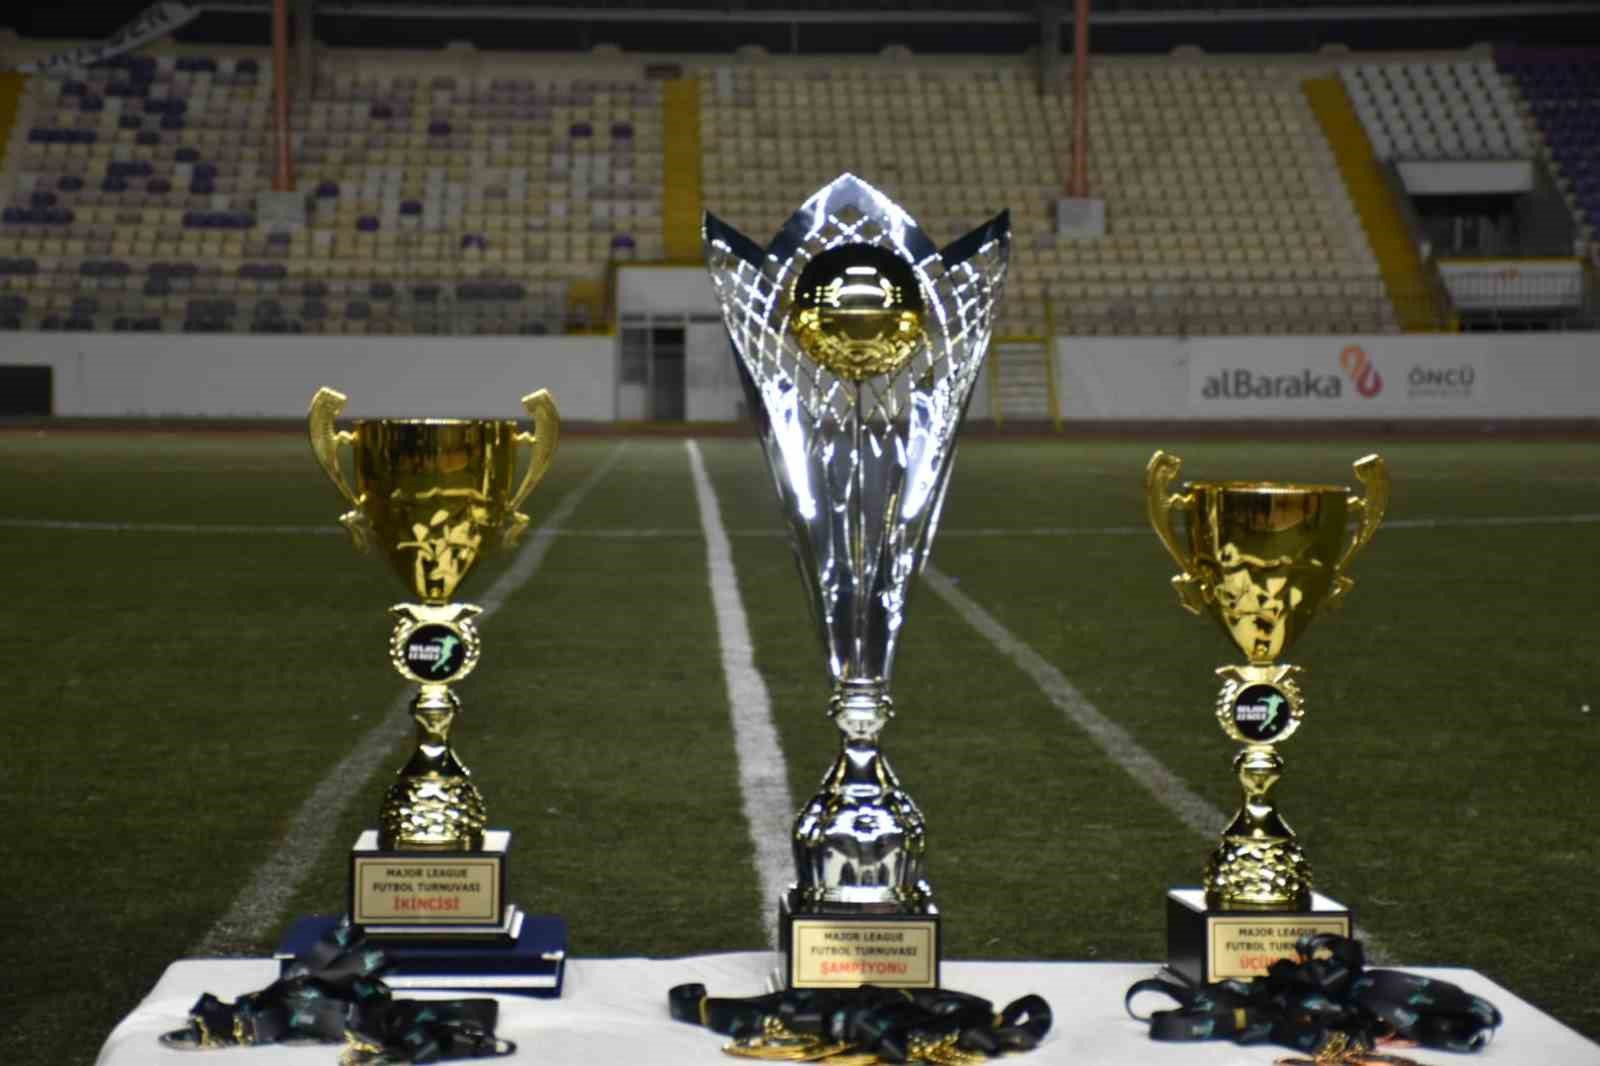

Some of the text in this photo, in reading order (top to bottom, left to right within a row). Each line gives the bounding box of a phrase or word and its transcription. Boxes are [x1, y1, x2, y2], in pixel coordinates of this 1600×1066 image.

[1408, 364, 1475, 386] ÖNCÜ
[1202, 368, 1342, 399] alBaraka
[386, 868, 468, 878] MAJOR LEAGUE
[373, 882, 480, 892] FUTBOL TURNUVASI
[824, 932, 904, 942] MAJOR LEAGUE
[1239, 928, 1273, 938] MAJOR
[810, 946, 917, 957] FUTBOL TURNUVASI
[1226, 941, 1265, 952] FUTBOL
